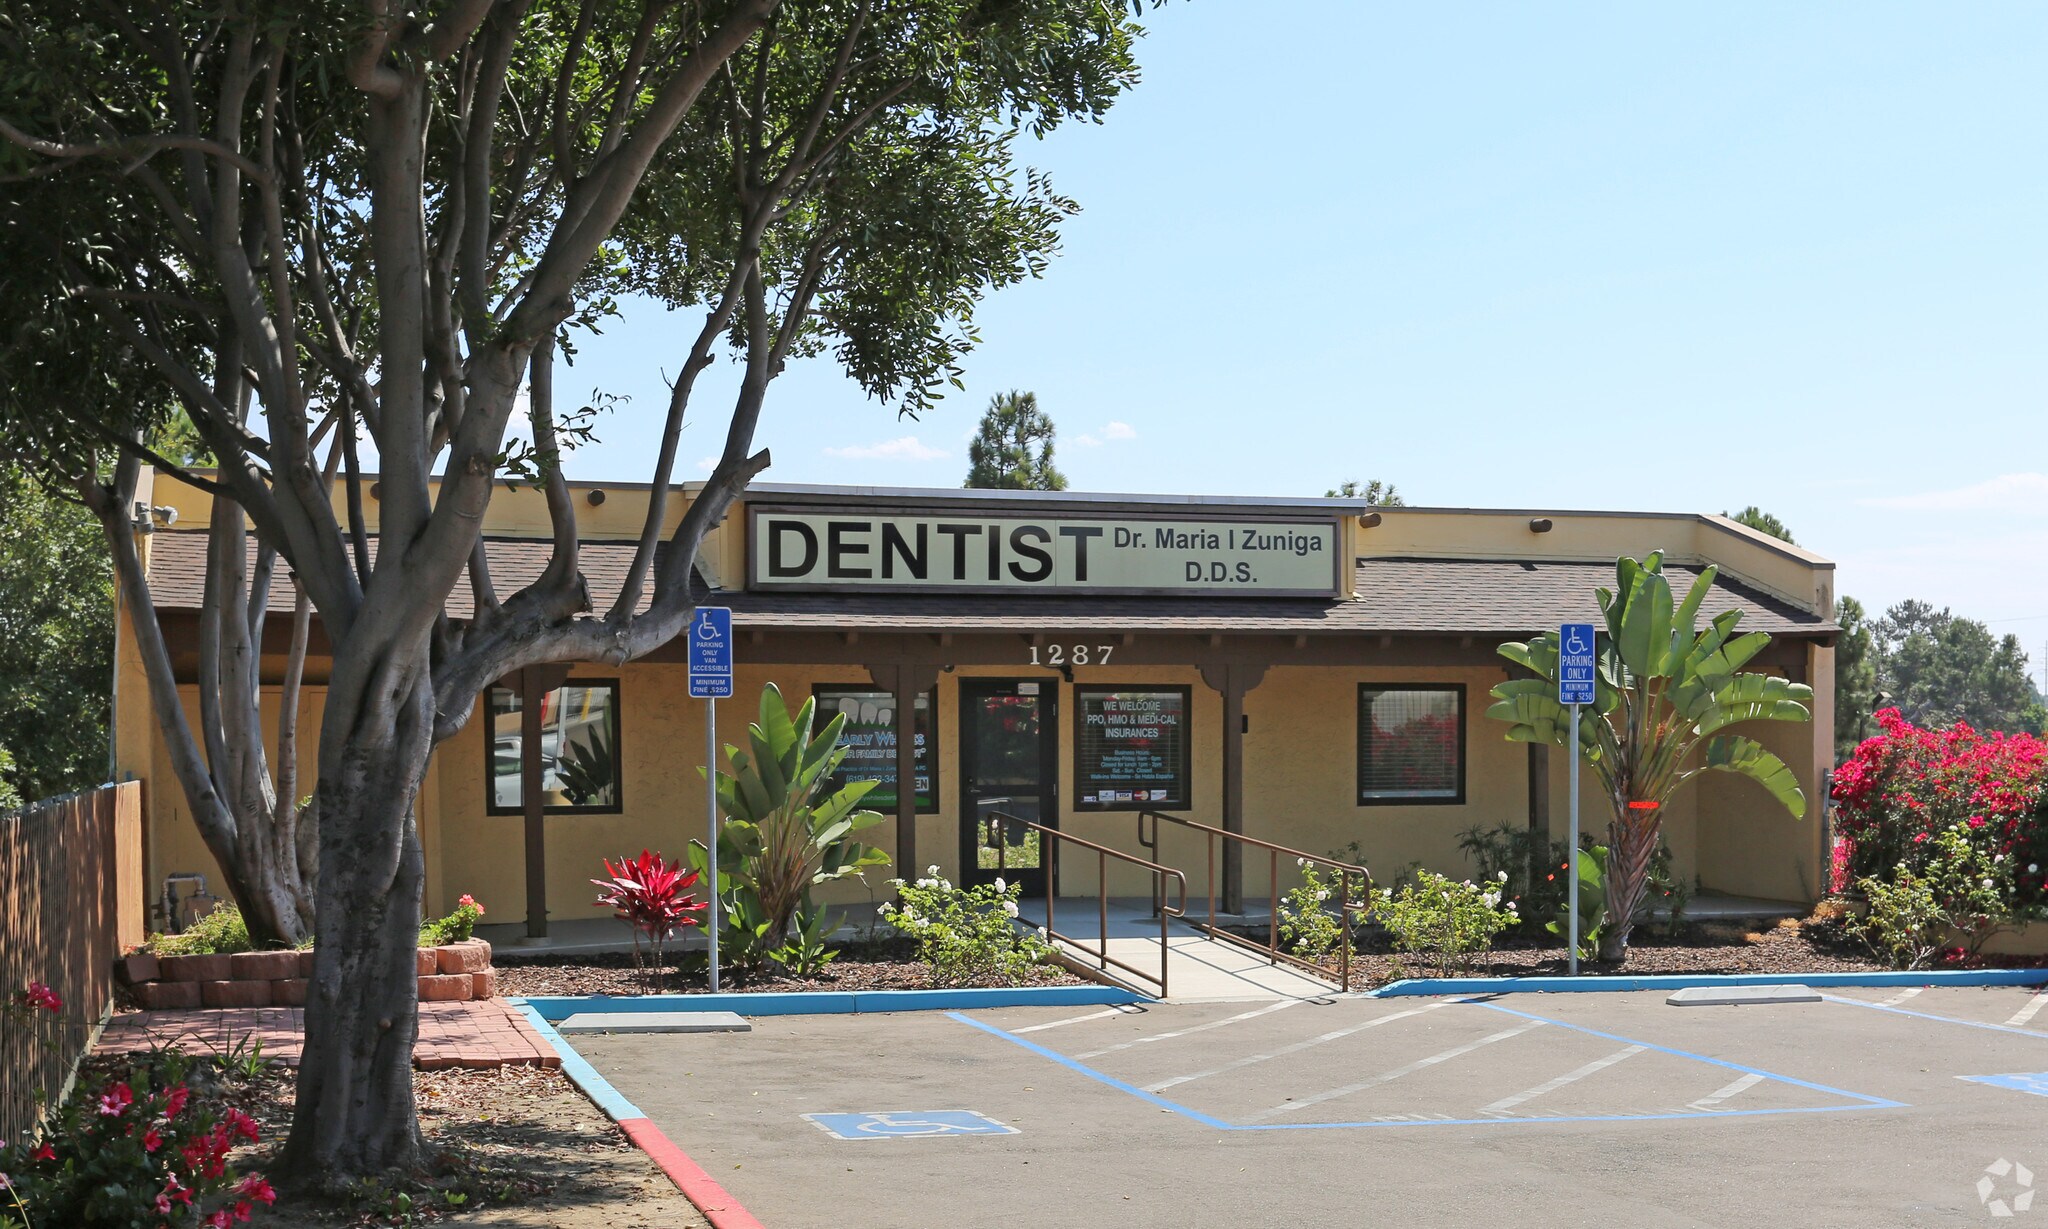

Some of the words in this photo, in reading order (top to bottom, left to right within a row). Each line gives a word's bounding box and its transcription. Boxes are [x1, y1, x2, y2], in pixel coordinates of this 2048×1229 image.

[1114, 527, 1146, 548] Dr.
[1155, 528, 1221, 550] Maria
[1228, 530, 1234, 550] I
[1242, 530, 1323, 557] Zuniga
[768, 520, 1103, 583] DENTIST
[1185, 561, 1259, 583] D.D.S.
[1029, 644, 1114, 665] 1287
[1562, 655, 1593, 667] PARKING
[1567, 668, 1587, 680] ONLY
[1565, 683, 1589, 691] MINIMUM
[1561, 692, 1574, 700] FINE
[1103, 701, 1117, 711] WE
[1119, 701, 1161, 711] WELCOME
[1087, 714, 1106, 725] PPO,
[1108, 714, 1128, 724] HMO
[1129, 714, 1136, 724] &
[1138, 714, 1177, 724] MEDI-CAL
[1105, 728, 1159, 738] INSURANCES
[836, 733, 873, 746] EARLY
[855, 749, 887, 759] FAMILY
